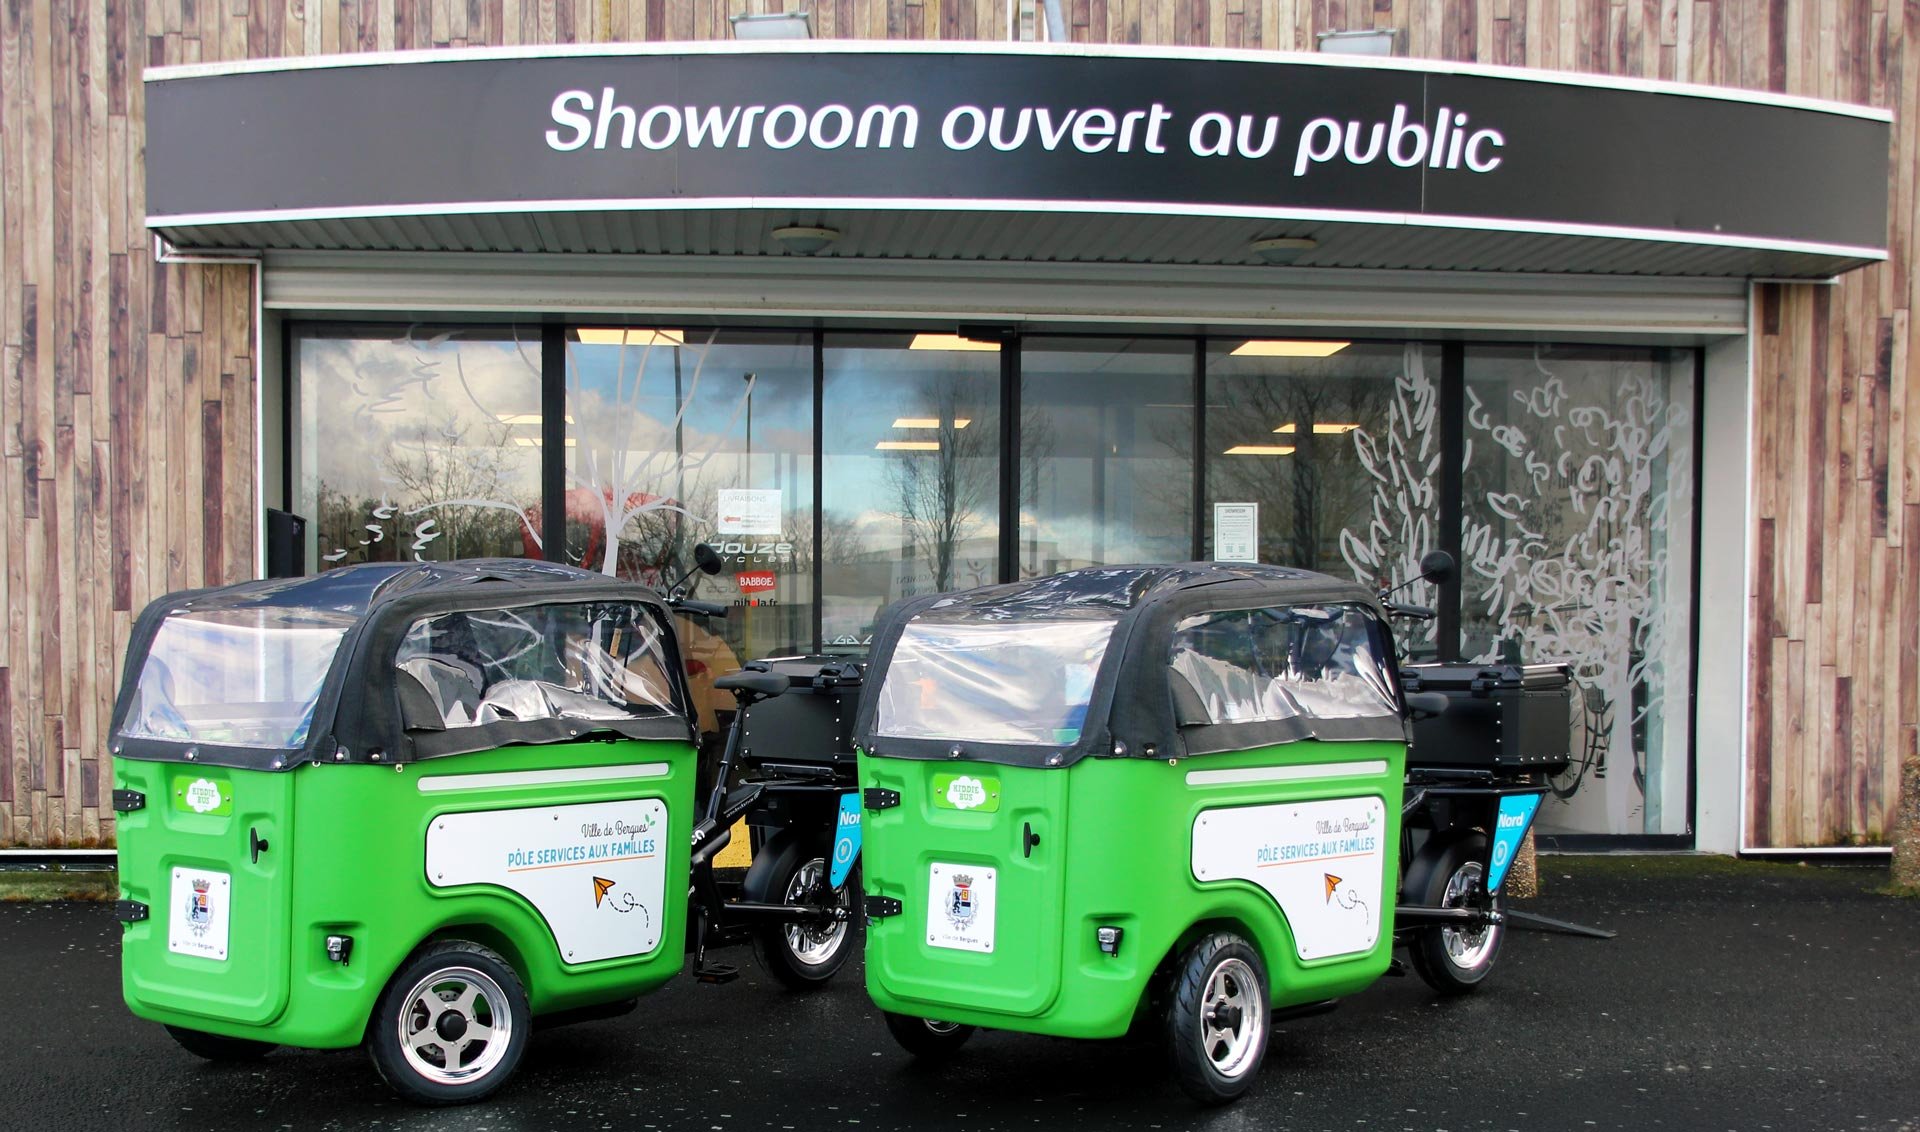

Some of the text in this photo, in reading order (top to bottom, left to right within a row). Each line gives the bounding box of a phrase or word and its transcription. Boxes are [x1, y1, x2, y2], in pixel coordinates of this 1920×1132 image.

[545, 87, 1505, 177] Showroom ouvert au public
[740, 577, 774, 587] BABBOE
[734, 598, 777, 607] nihola.fr
[959, 793, 974, 802] BUS
[1315, 817, 1370, 838] Ville de Bergues
[1498, 811, 1525, 828] Nord
[581, 820, 649, 840] Ville de Bergues
[508, 839, 656, 867] PÔLE SERVICES AUX FAMILLES
[1257, 836, 1376, 862] PÔLE SERVICES AUX FAMILLES
